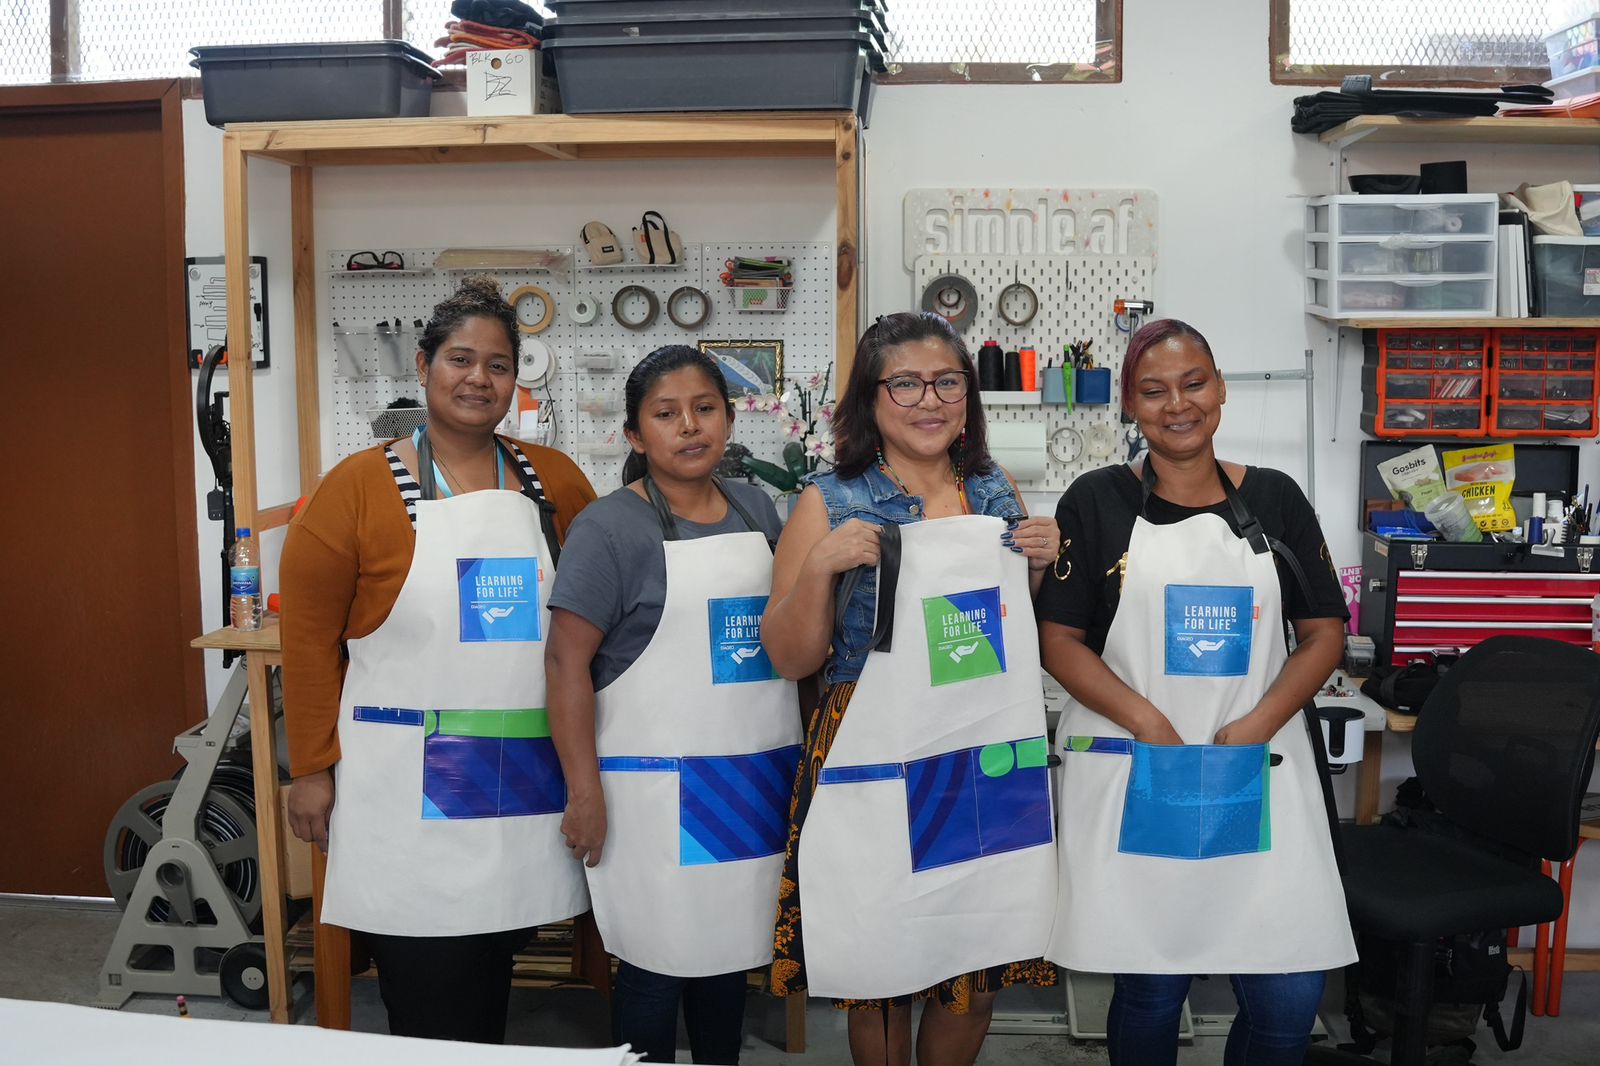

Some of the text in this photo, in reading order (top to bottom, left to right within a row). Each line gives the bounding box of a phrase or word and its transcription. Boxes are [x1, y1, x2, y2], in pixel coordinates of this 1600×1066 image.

[504, 53, 525, 65] 60
[1391, 459, 1427, 475] Gosbits
[1461, 485, 1496, 498] CHICKEN
[475, 575, 524, 587] LEARNING
[476, 587, 495, 598] FOR
[942, 608, 987, 626] LEARNING
[1184, 605, 1237, 618] LEARNING
[725, 615, 763, 627] LEARNIN
[1184, 618, 1204, 630] FOR
[725, 626, 760, 639] FOR LIF
[943, 625, 961, 639] FOR
